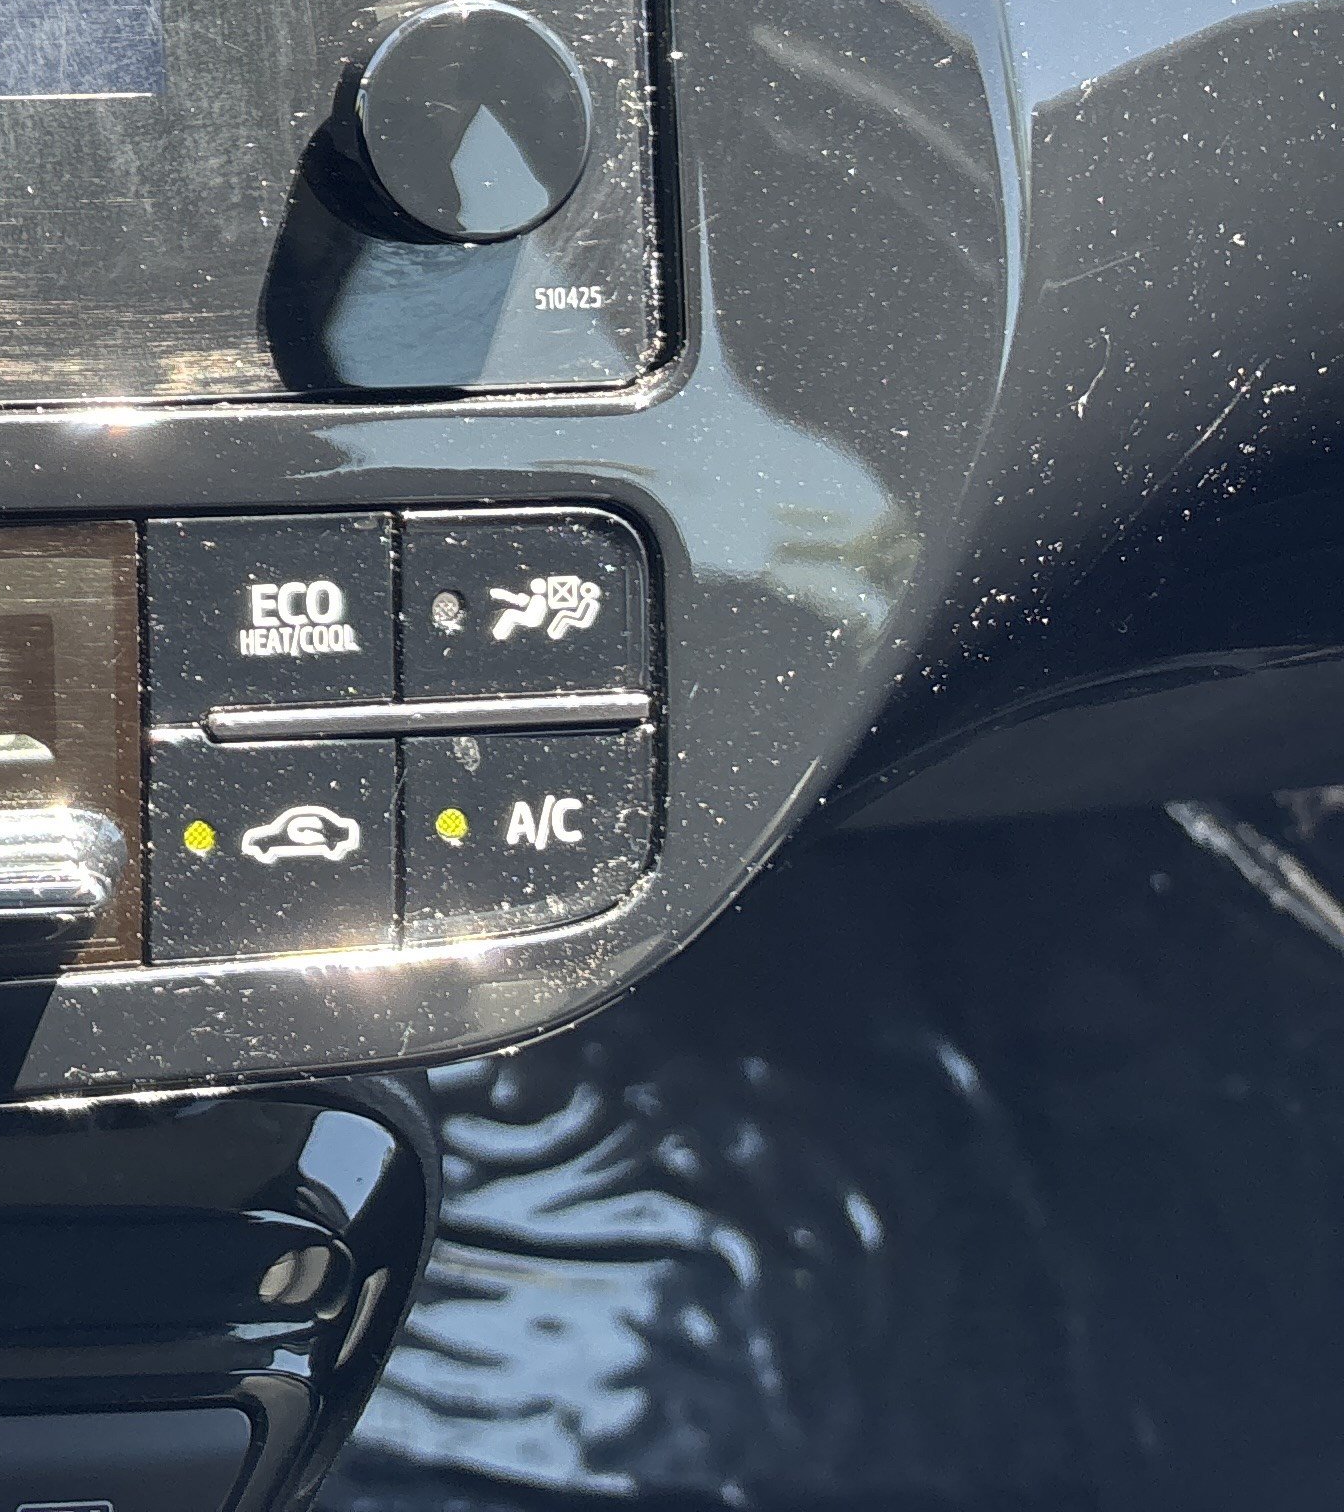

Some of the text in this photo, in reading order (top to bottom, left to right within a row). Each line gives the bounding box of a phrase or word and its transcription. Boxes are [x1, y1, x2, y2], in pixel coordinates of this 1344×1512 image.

[534, 285, 602, 310] 510425
[251, 580, 344, 628] ECO
[239, 624, 362, 657] HEAT/COOL
[505, 794, 583, 850] A/C
